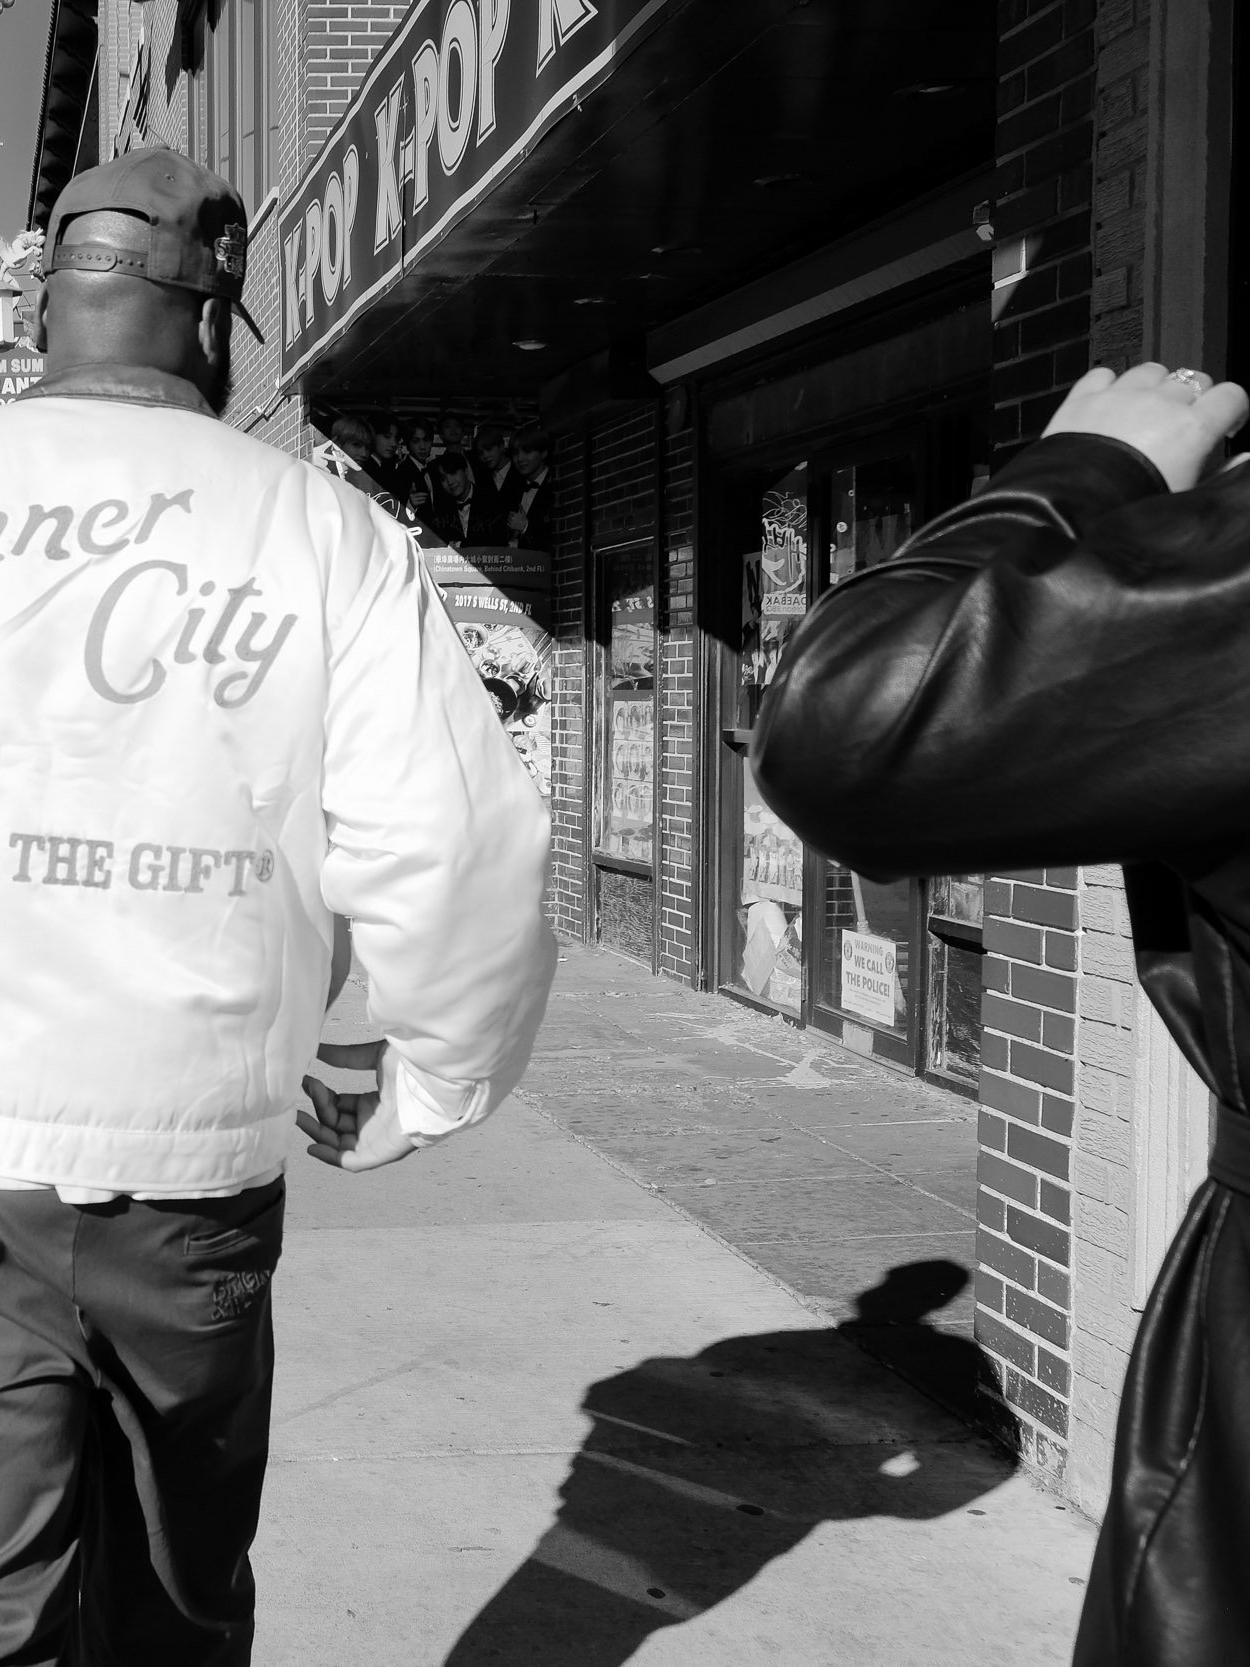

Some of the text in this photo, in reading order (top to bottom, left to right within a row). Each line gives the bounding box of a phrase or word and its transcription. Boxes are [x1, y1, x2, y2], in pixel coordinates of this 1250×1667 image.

[373, 0, 512, 257] K-POP
[283, 143, 359, 353] K-POP
[11, 358, 44, 373] SUM
[454, 594, 532, 616] 2017 S WELLS ST, 2ND FL
[84, 560, 299, 709] City
[9, 832, 115, 890] THE
[855, 939, 884, 956] WARNING
[854, 956, 884, 976] WE CALL
[846, 970, 861, 988] THE
[862, 976, 890, 998] POLICE!
